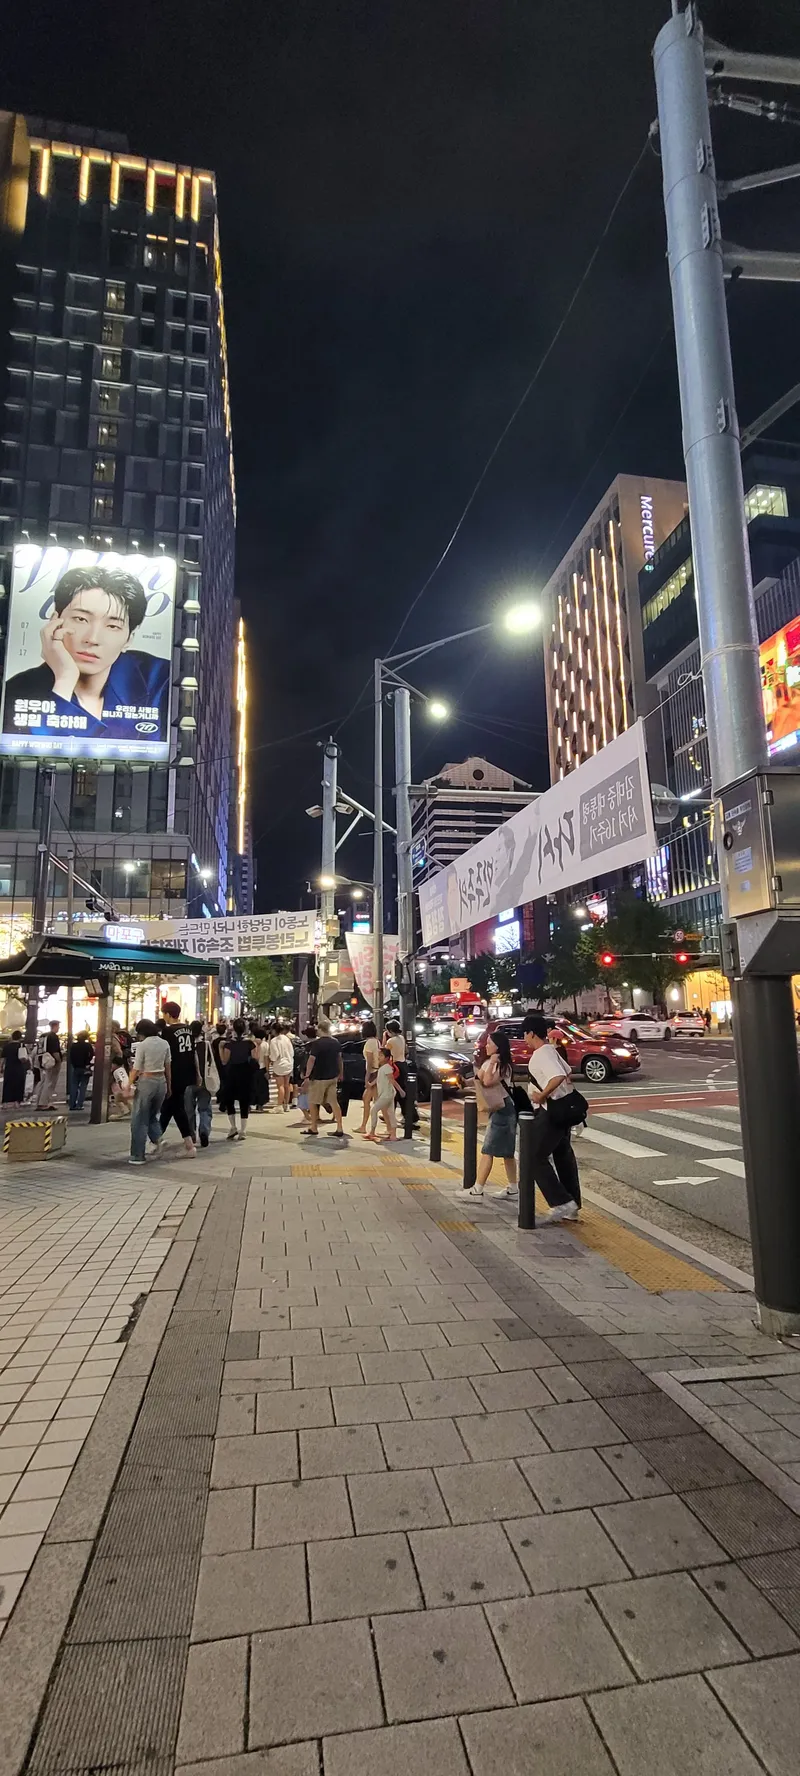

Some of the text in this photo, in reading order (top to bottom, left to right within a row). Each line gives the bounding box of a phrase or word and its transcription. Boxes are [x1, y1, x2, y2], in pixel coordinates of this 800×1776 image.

[640, 495, 655, 560] Mercure
[14, 699, 56, 713] 원우야
[13, 713, 88, 729] 생일 축하해
[107, 926, 143, 942] 마포구
[178, 1034, 193, 1052] 24
